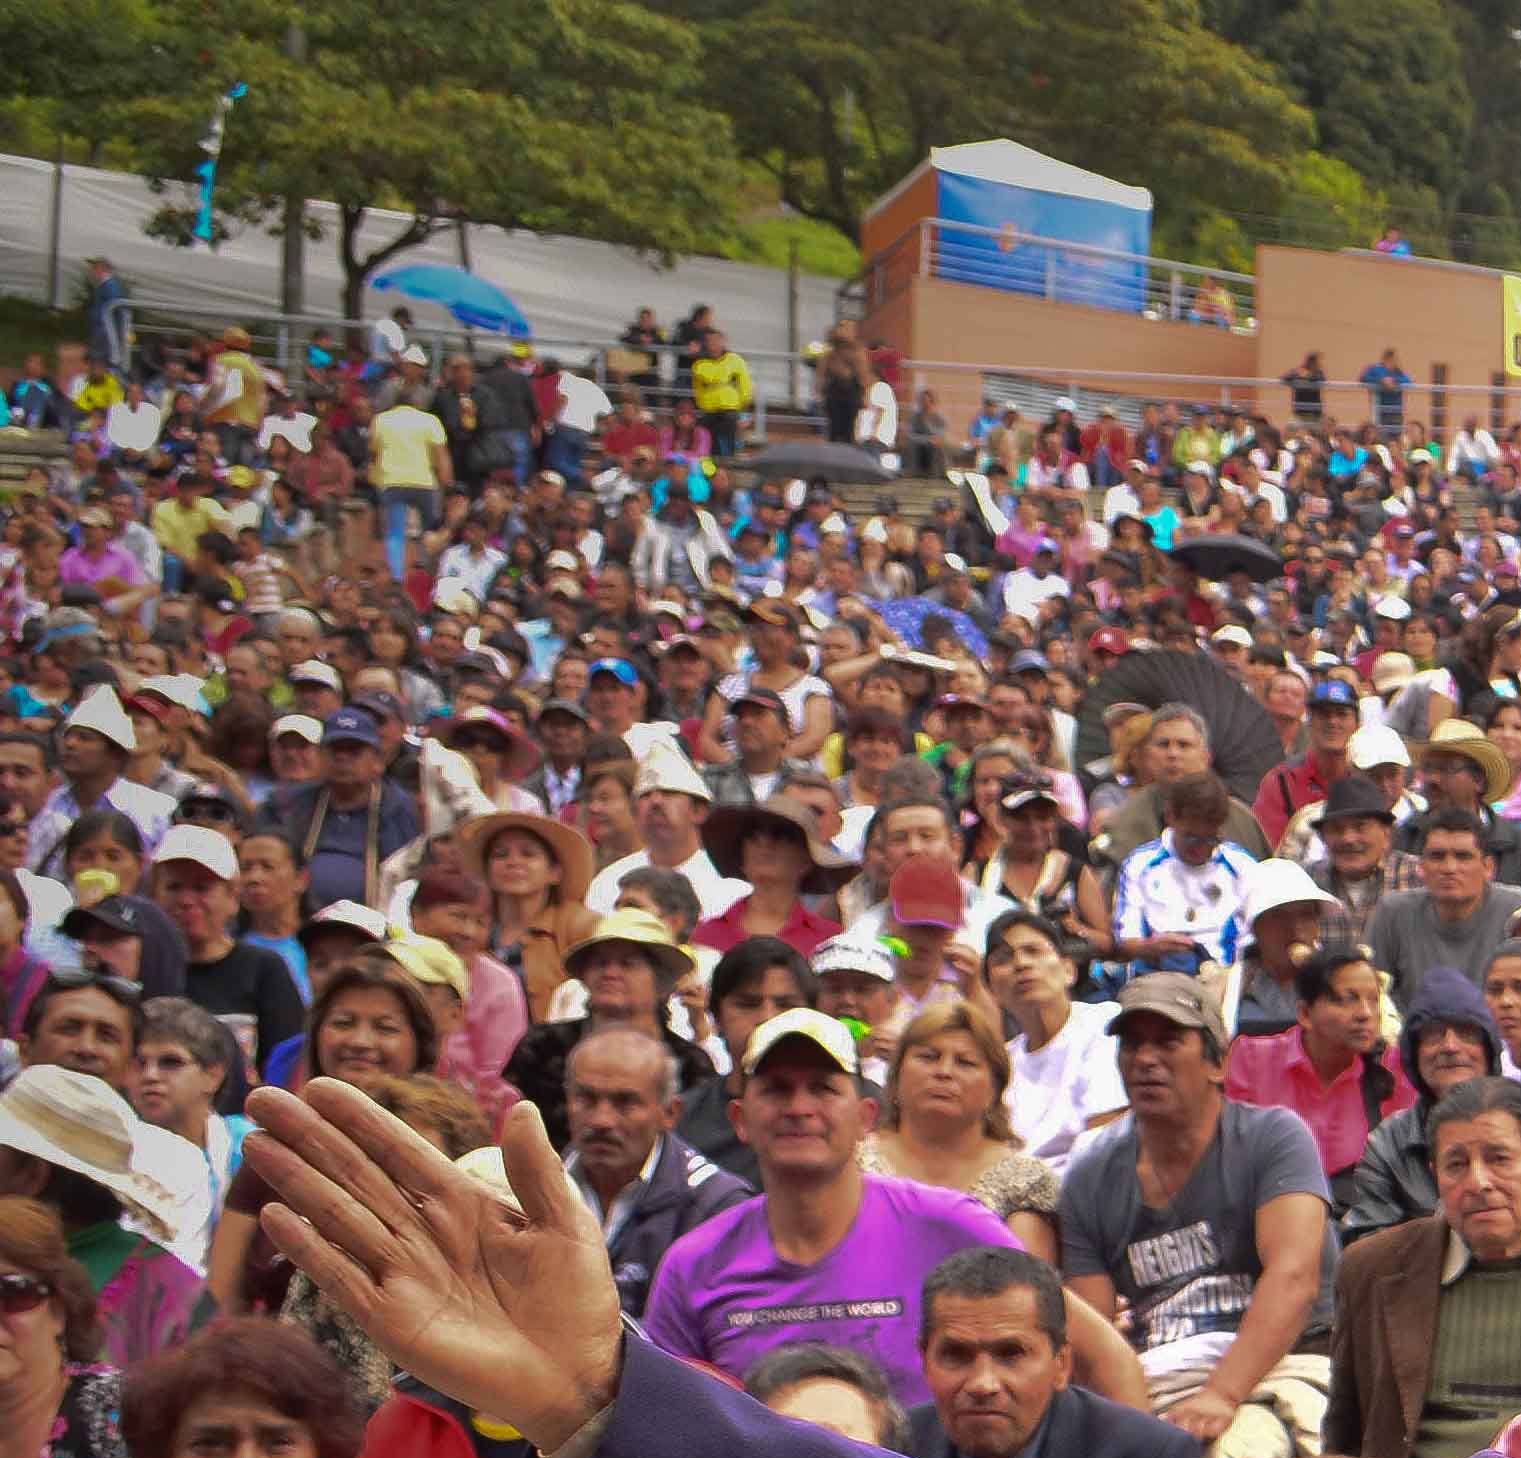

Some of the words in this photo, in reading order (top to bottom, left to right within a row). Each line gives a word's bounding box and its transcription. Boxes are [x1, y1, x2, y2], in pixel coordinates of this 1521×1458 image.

[1127, 1220, 1217, 1288] HEIGHTS
[754, 1305, 818, 1324] CHANGE
[819, 1303, 842, 1320] THE
[847, 1301, 898, 1317] WORLD
